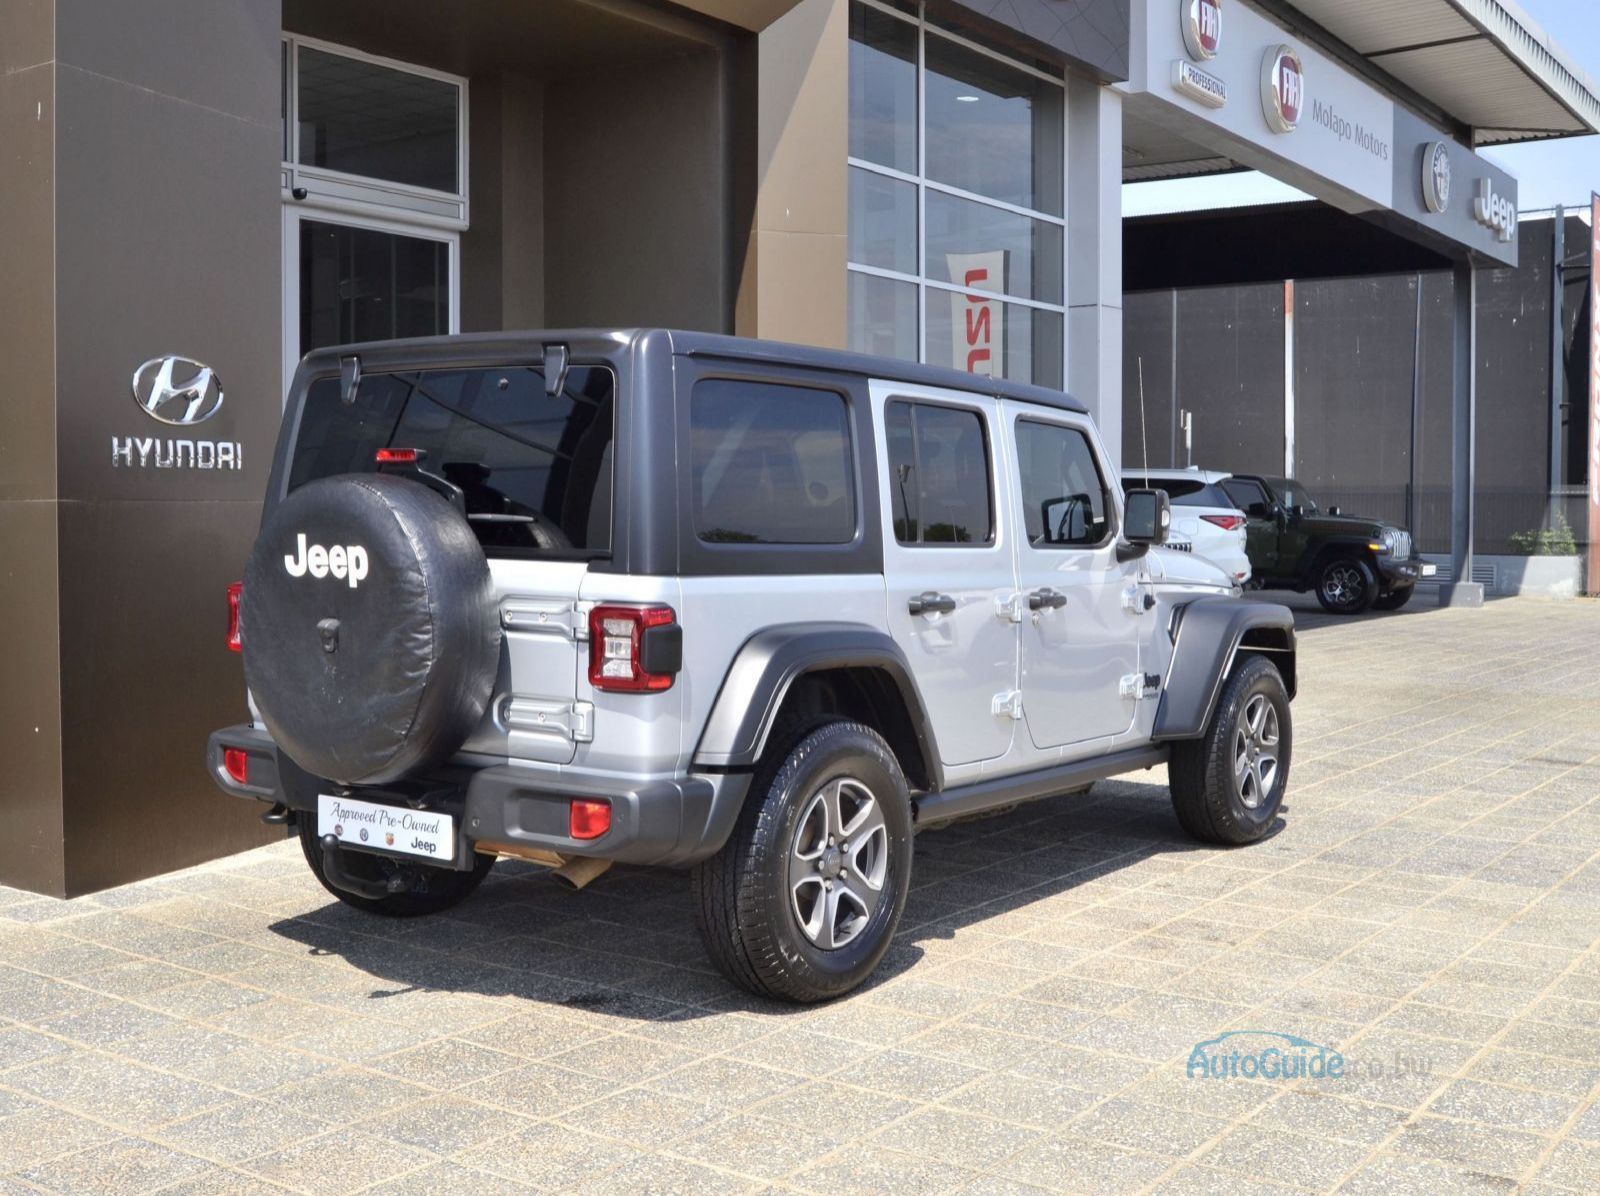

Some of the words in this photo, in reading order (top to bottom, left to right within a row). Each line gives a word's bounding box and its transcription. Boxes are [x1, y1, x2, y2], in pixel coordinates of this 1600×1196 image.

[1188, 67, 1226, 99] PROFESSIONAL
[1312, 98, 1351, 142] Molapo
[1354, 123, 1388, 161] Motors
[1477, 178, 1515, 240] Jeep
[112, 436, 242, 470] HYUNDAI
[284, 533, 369, 588] Jeep
[330, 801, 376, 824] Approved
[379, 809, 440, 834] Pre-Owned
[411, 837, 437, 854] Jeep
